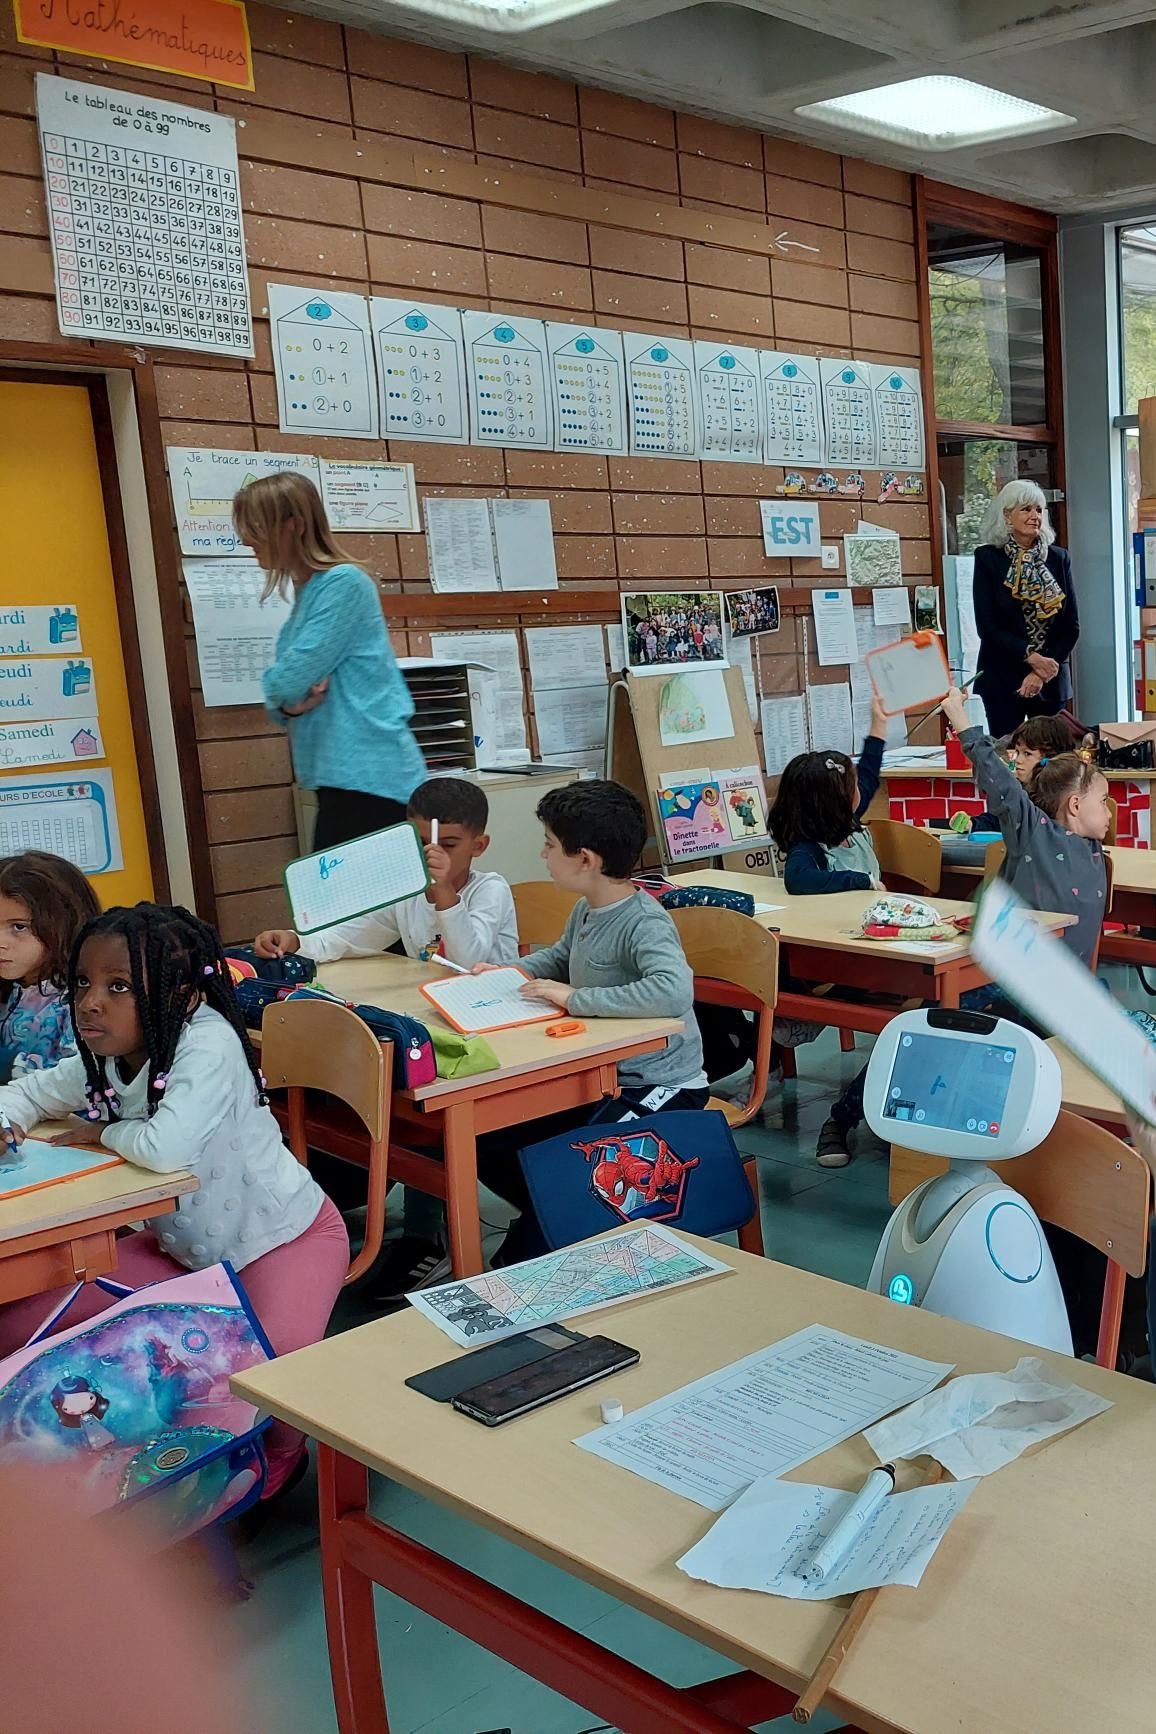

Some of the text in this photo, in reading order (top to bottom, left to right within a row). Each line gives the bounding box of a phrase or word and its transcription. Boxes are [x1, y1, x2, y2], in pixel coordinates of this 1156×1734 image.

[65, 91, 212, 134] Le tableau des nombres
[112, 116, 128, 128] de
[144, 119, 153, 133] à
[156, 124, 170, 136] 99
[71, 141, 78, 153] 1
[90, 145, 101, 159] 2
[109, 149, 120, 162] 3
[130, 153, 140, 165] 4
[150, 156, 159, 169] 5
[169, 160, 179, 173] 6
[187, 165, 197, 176] 7
[207, 168, 215, 181] 8
[222, 172, 231, 184] 9
[67, 160, 84, 173] 11
[89, 164, 107, 178] 12
[108, 167, 126, 181] 13
[129, 171, 146, 185] 14
[148, 174, 164, 188] 15
[166, 178, 182, 192] 16
[186, 182, 201, 195] 17
[203, 185, 219, 199] 18
[221, 189, 236, 203] 19
[70, 179, 86, 193] 21
[90, 182, 109, 198] 22
[110, 186, 128, 201] 23
[129, 189, 147, 204] 24
[149, 193, 166, 207] 25
[168, 196, 185, 211] 26
[187, 200, 203, 214] 27
[205, 203, 221, 217] 28
[223, 207, 238, 221] 29
[314, 306, 322, 318] 2
[411, 317, 420, 329] 3
[500, 330, 508, 340] 4
[339, 341, 349, 354] 2
[581, 341, 588, 351] 5
[341, 372, 348, 385] 1
[187, 452, 203, 463] Je
[212, 452, 241, 465] trace
[245, 454, 258, 466] un
[263, 457, 300, 474] segment
[183, 467, 193, 477] A
[182, 519, 230, 532] Attention
[770, 517, 814, 545] EST
[216, 535, 243, 552] règle
[0, 610, 26, 624] rdi
[0, 724, 55, 741] Samedi
[682, 841, 720, 854] tractopelle
